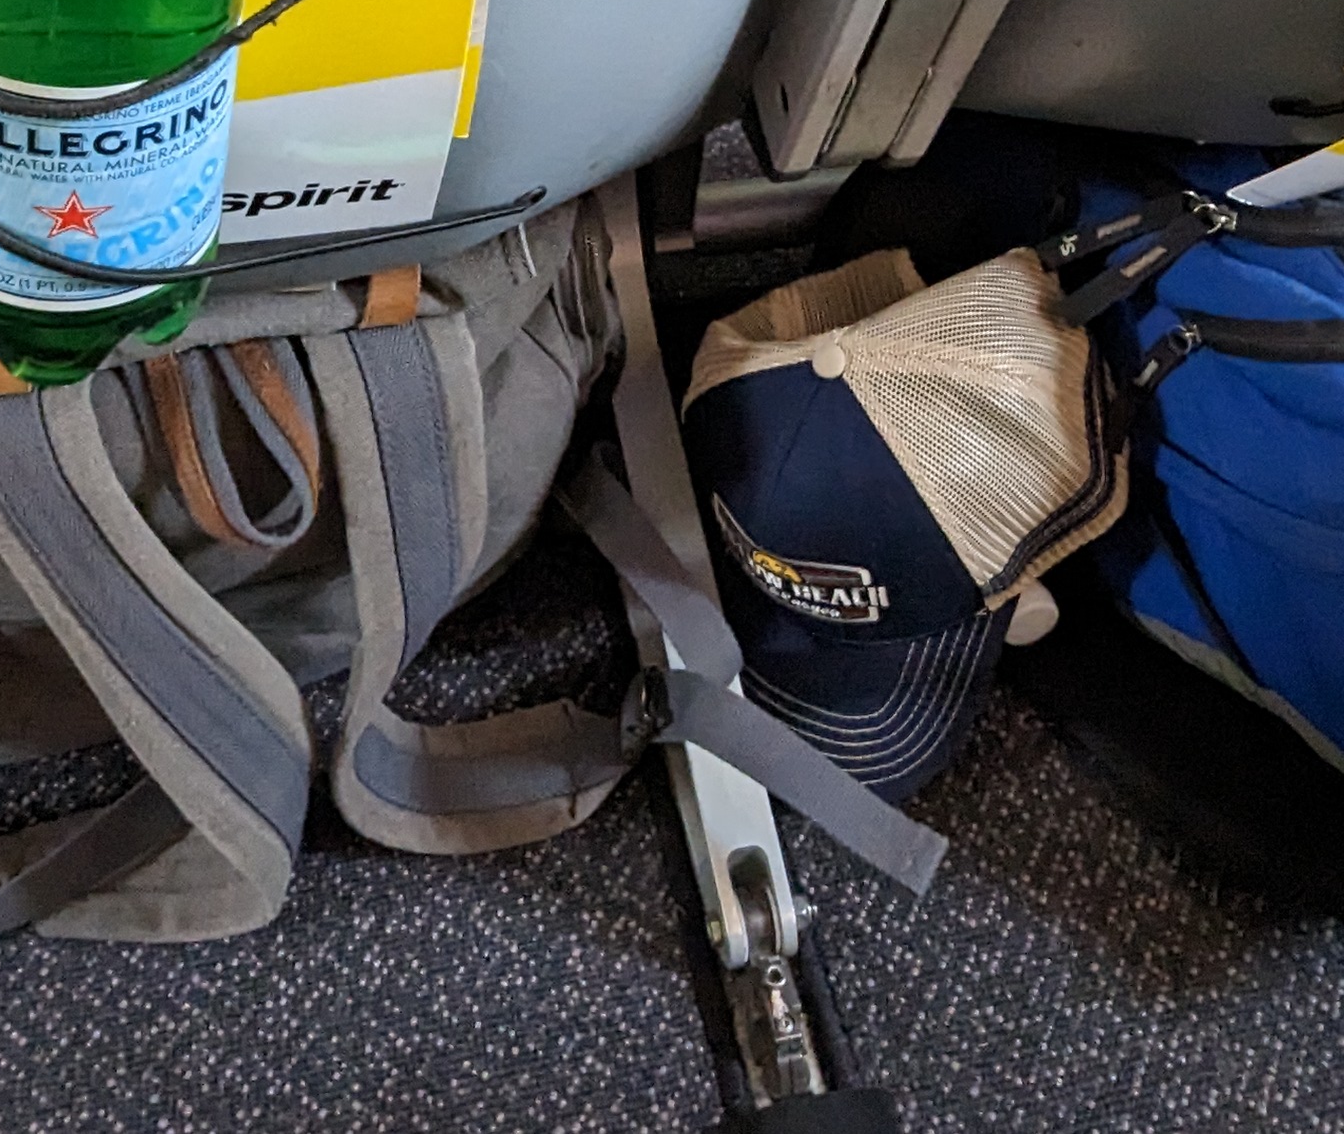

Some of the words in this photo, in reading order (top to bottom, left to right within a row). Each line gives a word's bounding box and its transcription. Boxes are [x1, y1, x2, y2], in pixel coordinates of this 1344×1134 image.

[0, 152, 95, 174] NATURAL
[104, 137, 187, 172] MINERAL
[221, 177, 399, 218] spirit
